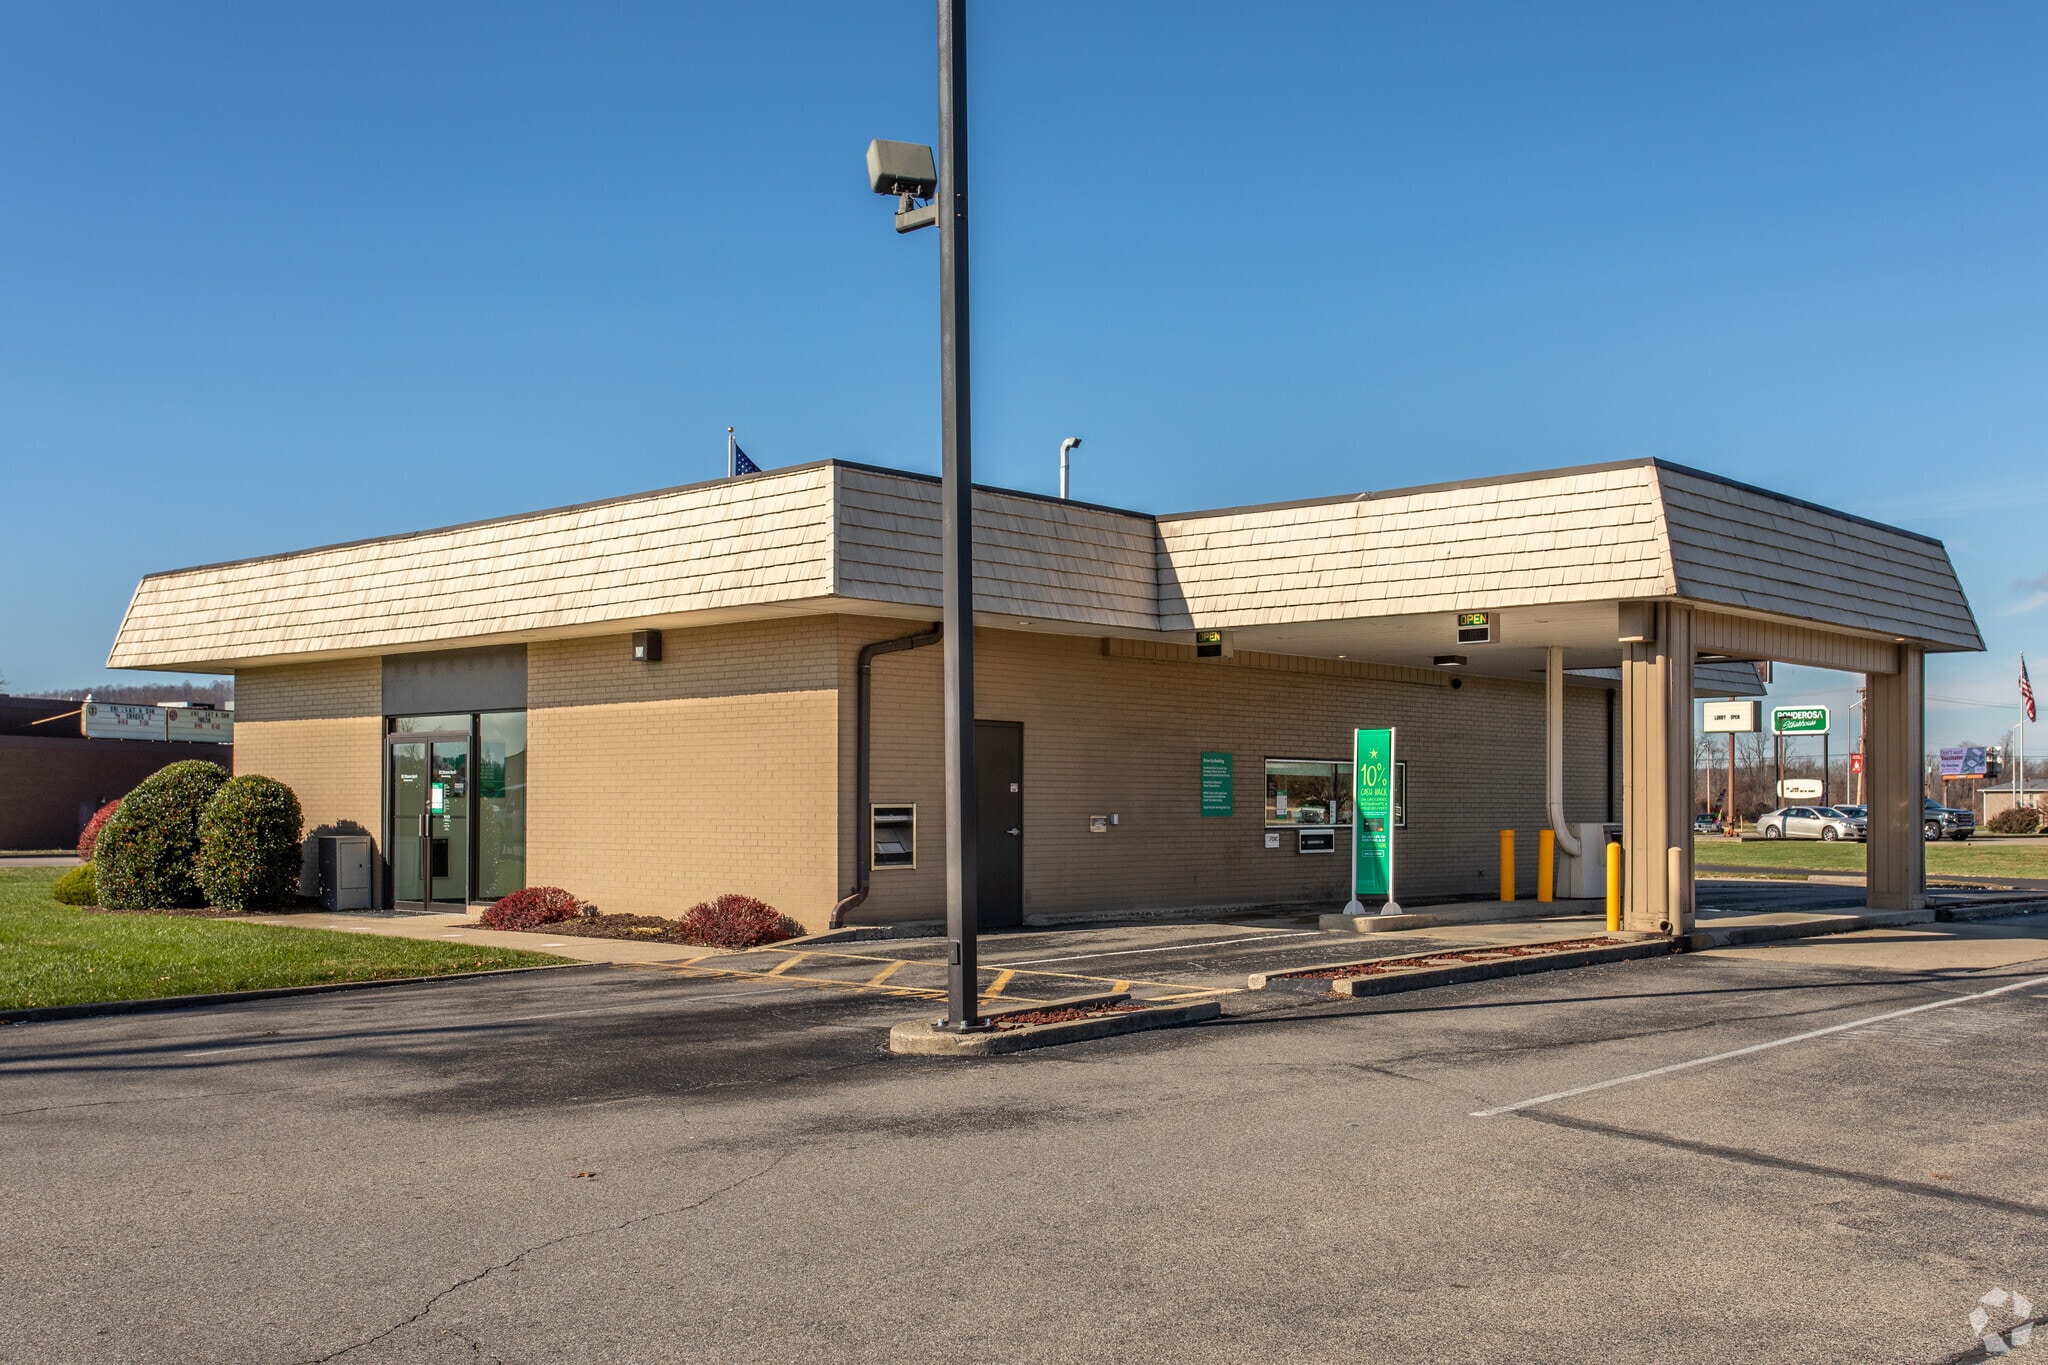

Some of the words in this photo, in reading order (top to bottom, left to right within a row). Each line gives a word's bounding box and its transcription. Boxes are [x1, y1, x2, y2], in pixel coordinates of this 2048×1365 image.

[1460, 613, 1487, 625] OPEN
[1199, 631, 1221, 642] OPEN
[1777, 710, 1824, 719] PONDEROSA
[1360, 763, 1387, 787] 10%
[1360, 788, 1373, 796] CASH
[1375, 788, 1388, 796] BACK
